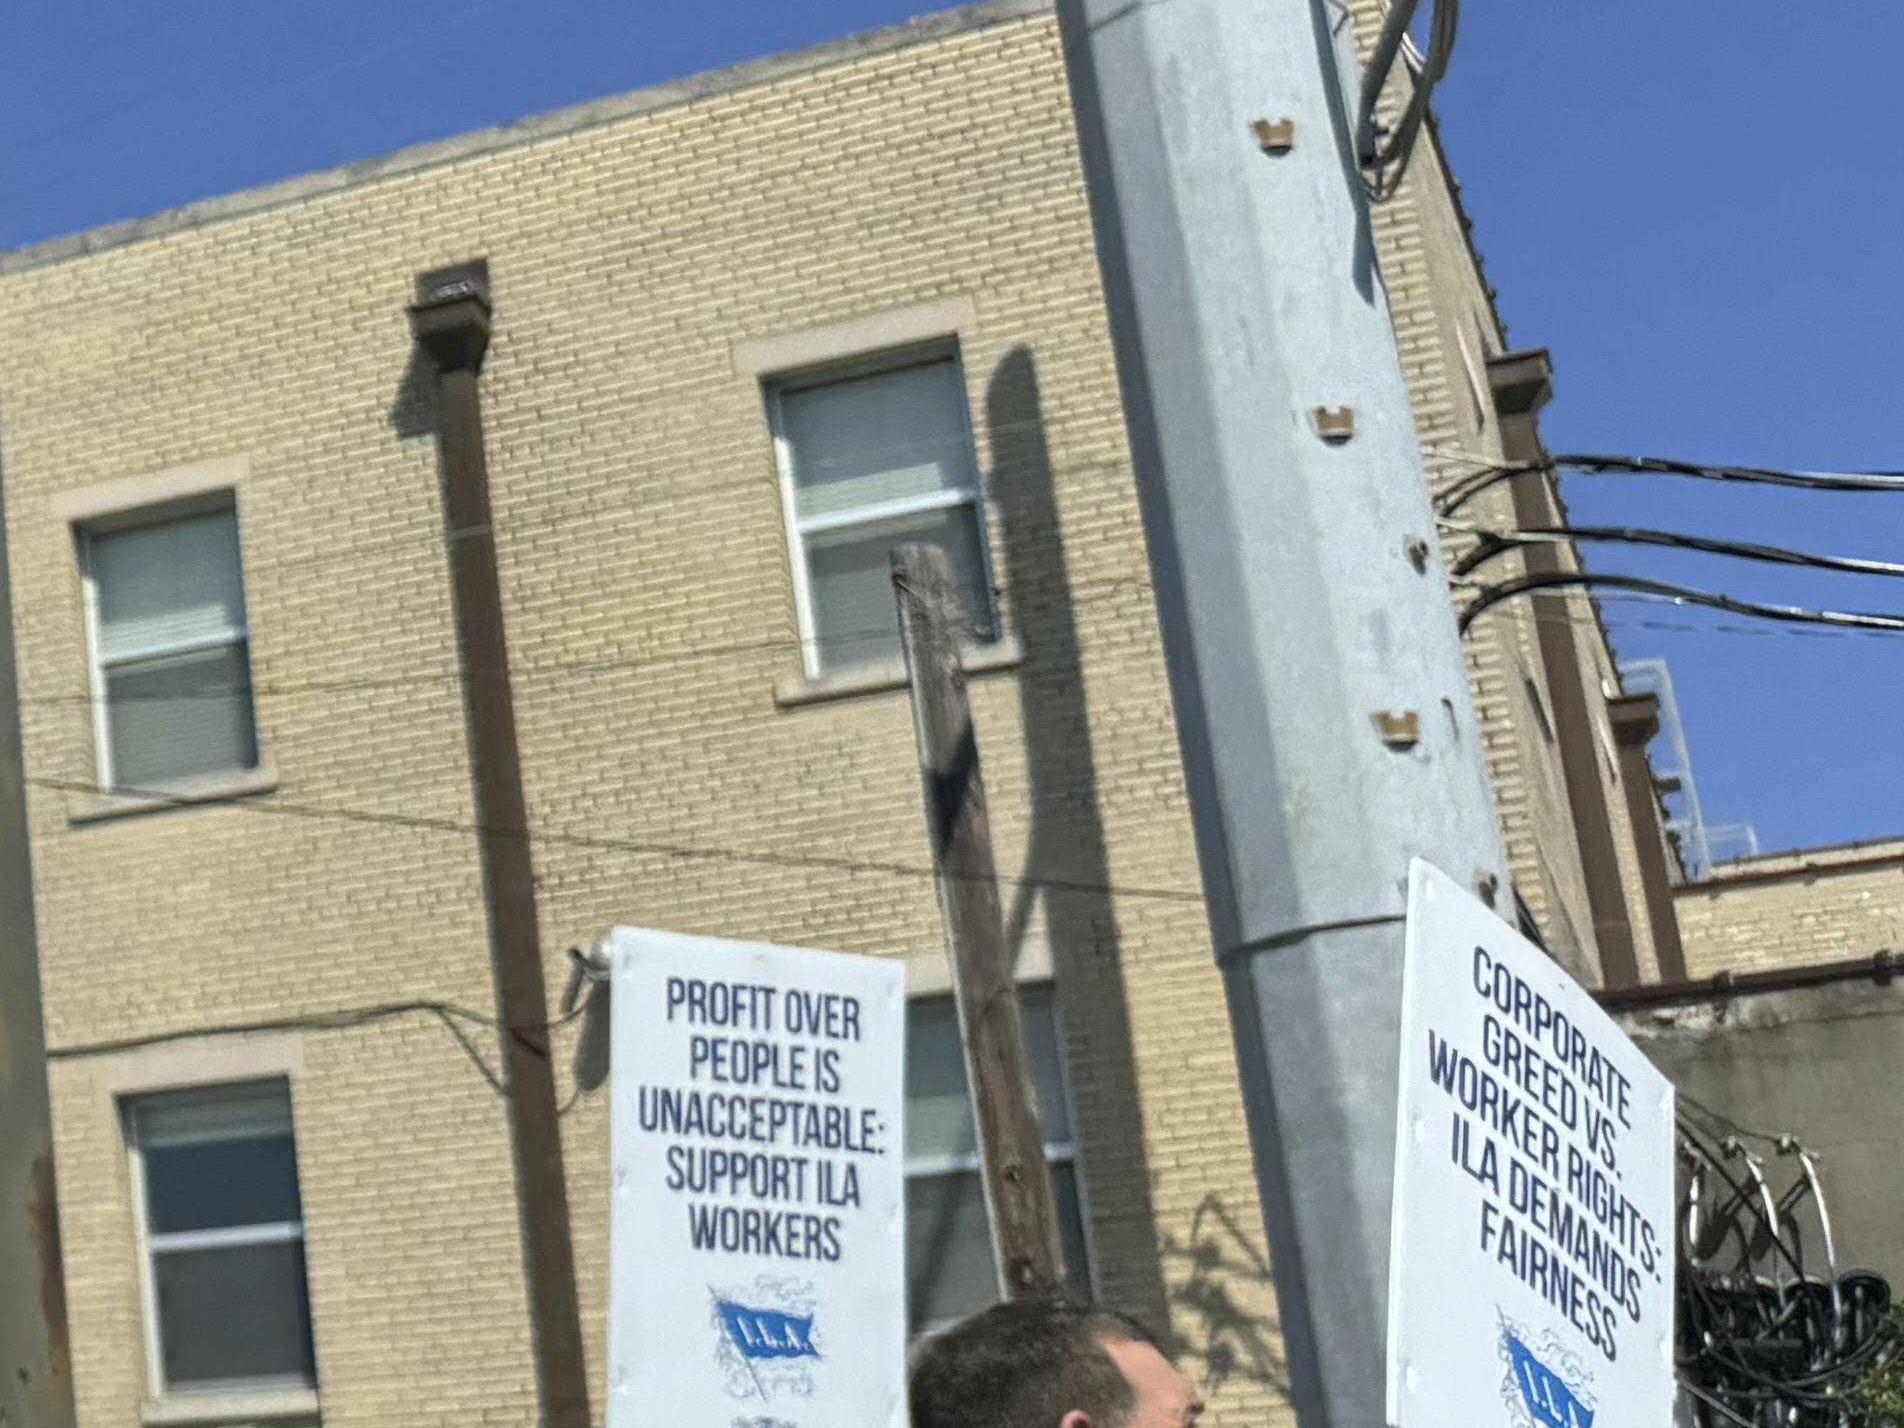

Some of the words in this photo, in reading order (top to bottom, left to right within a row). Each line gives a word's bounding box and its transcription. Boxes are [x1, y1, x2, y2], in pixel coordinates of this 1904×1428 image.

[665, 975, 778, 1035] PROFIT
[786, 988, 861, 1042] OVER
[1472, 944, 1632, 1130] CORPORATE
[690, 1037, 806, 1091] PEOPLE
[814, 1050, 841, 1094] IS
[1483, 1013, 1578, 1130] GREED
[1584, 1104, 1623, 1180] VS.
[638, 1084, 887, 1157] UNACCEPTABLE:
[1429, 1029, 1562, 1174] WORKER
[1567, 1157, 1664, 1285] RIGHTS:
[665, 1145, 807, 1202] SUPPORT
[816, 1161, 861, 1209] ILA
[688, 1203, 842, 1264] WORKERS
[1450, 1110, 1502, 1197] ILA
[1507, 1155, 1642, 1325] DEMANDS
[1479, 1197, 1617, 1363] FAIRNESS
[736, 1316, 810, 1351] I.L.A.
